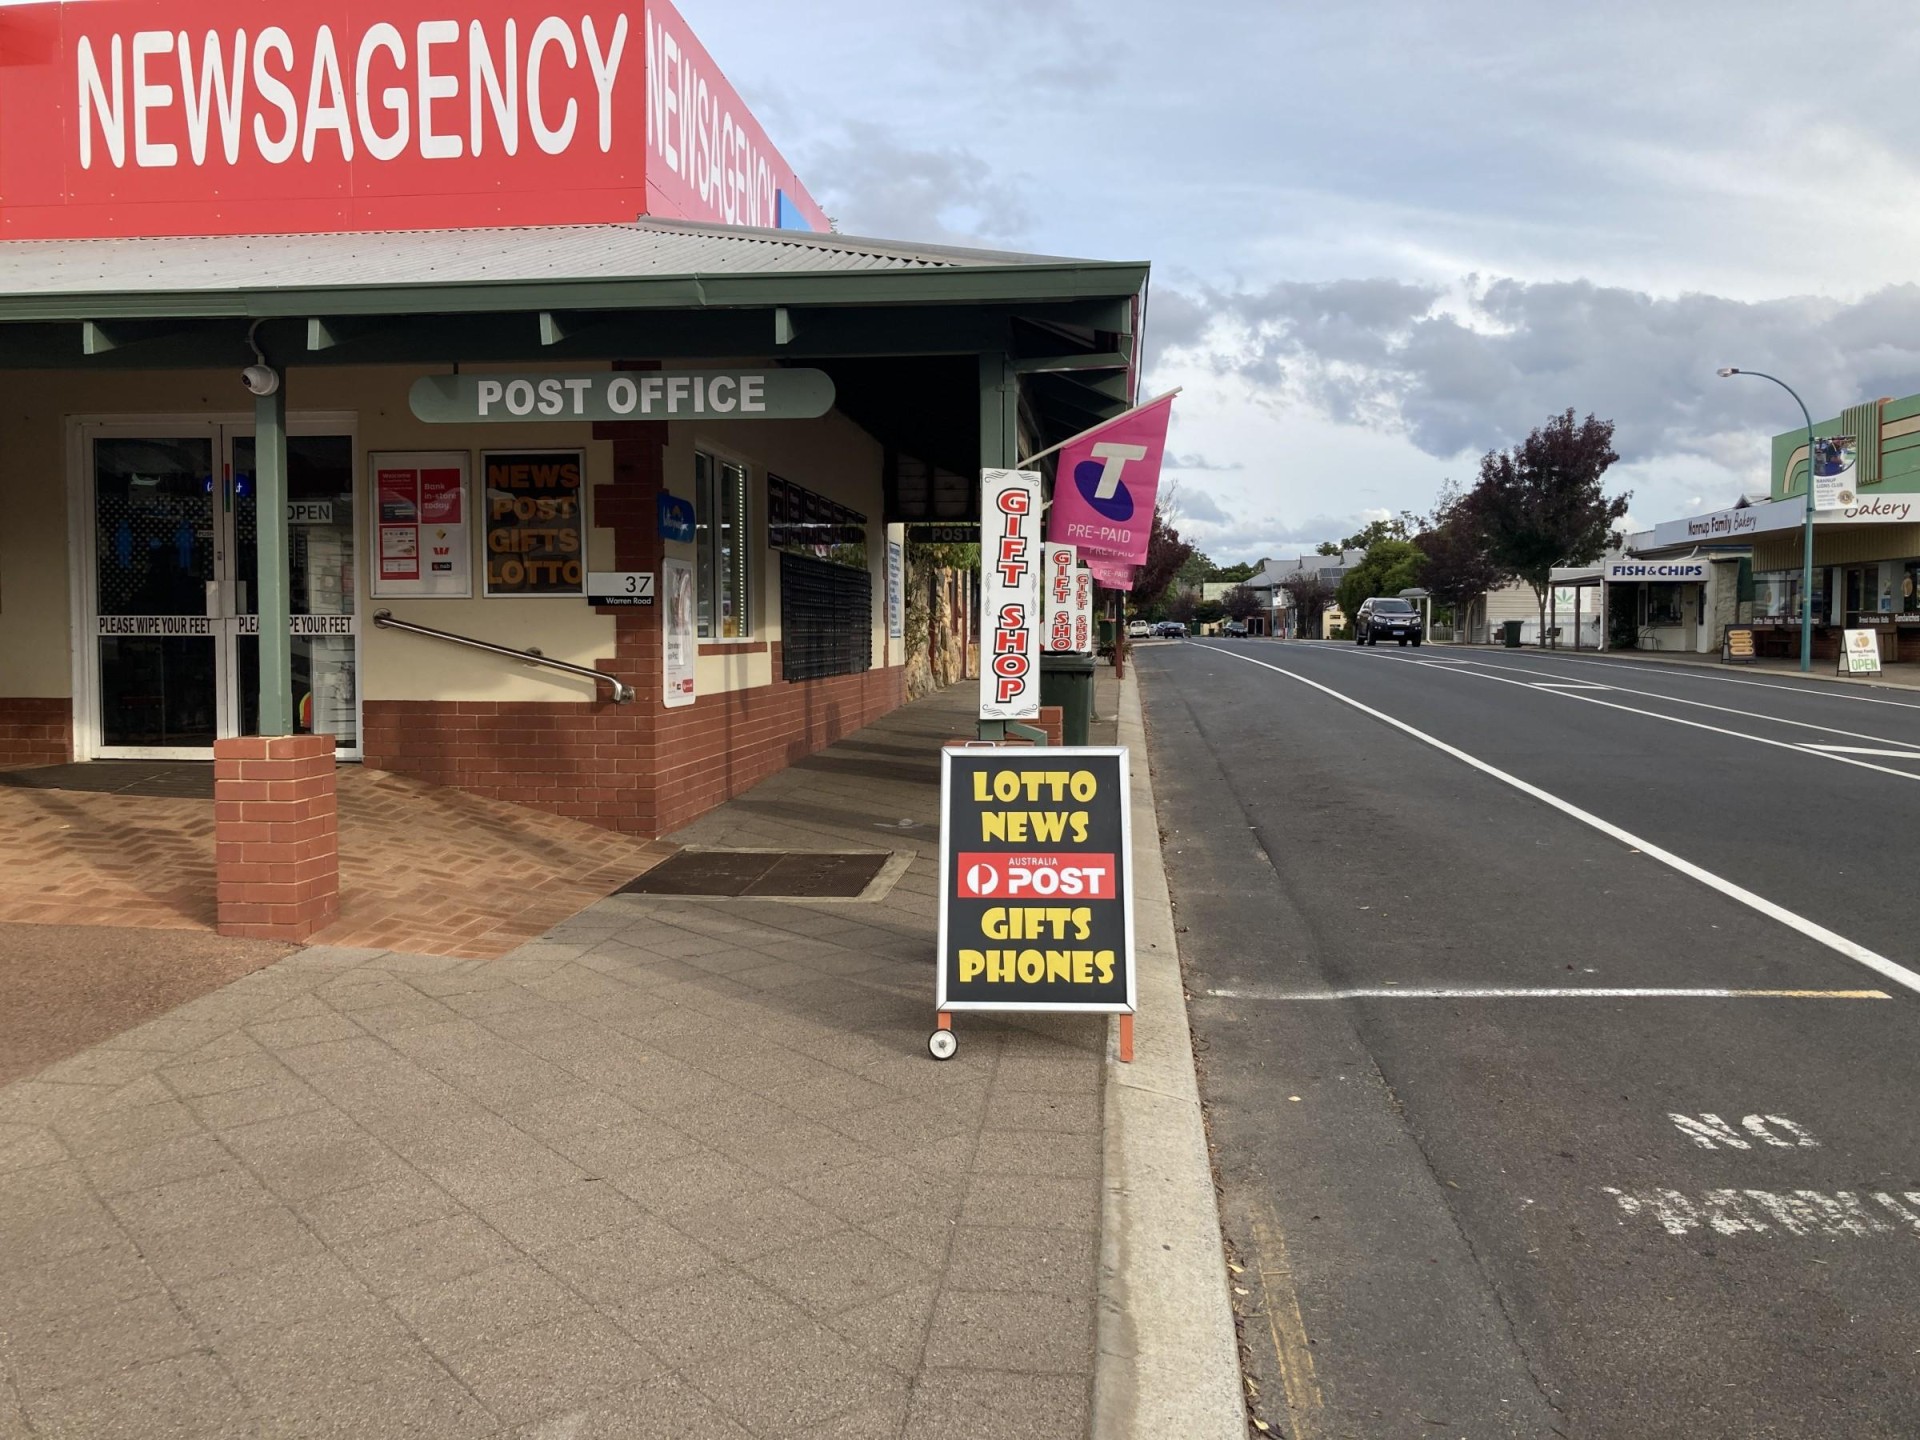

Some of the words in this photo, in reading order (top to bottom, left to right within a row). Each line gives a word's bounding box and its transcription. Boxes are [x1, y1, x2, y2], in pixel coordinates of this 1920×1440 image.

[77, 13, 629, 169] NEWSAGENCY
[646, 8, 776, 228] NEWSAGENCY
[477, 379, 592, 416] POST
[605, 375, 766, 414] OFFICE
[488, 463, 579, 489] NEWS
[424, 492, 457, 500] in-store
[493, 496, 575, 519] POST
[931, 529, 973, 541] POST
[1067, 523, 1132, 543] PRE-PAID
[1711, 516, 1732, 534] Family
[1733, 512, 1757, 531] Bakery
[488, 528, 578, 553] GIFTS
[996, 488, 1030, 588] GIFT
[488, 560, 580, 585] LOTTO
[1053, 550, 1071, 603] GIFT
[1612, 566, 1646, 576] FISH
[1657, 565, 1703, 576] CHIPS
[625, 576, 651, 592] 37
[1076, 573, 1089, 610] GIFT
[100, 617, 134, 633] PLEASE
[135, 617, 160, 633] WIPE
[161, 617, 188, 633] YOUR
[189, 617, 211, 633] FEET
[301, 617, 327, 633] YOUR
[329, 617, 351, 633] FEET
[1051, 611, 1071, 650] SHO
[992, 604, 1030, 703] SHOP
[1852, 658, 1877, 670] OPEN
[973, 770, 1096, 802] LOTTO
[981, 811, 1088, 842] NEWS
[1009, 857, 1057, 865] AUSTRALIA
[1008, 867, 1105, 894] POST
[981, 907, 1091, 939] GIFTS
[958, 949, 1114, 983] PHONES
[1668, 1113, 1820, 1149] NO
